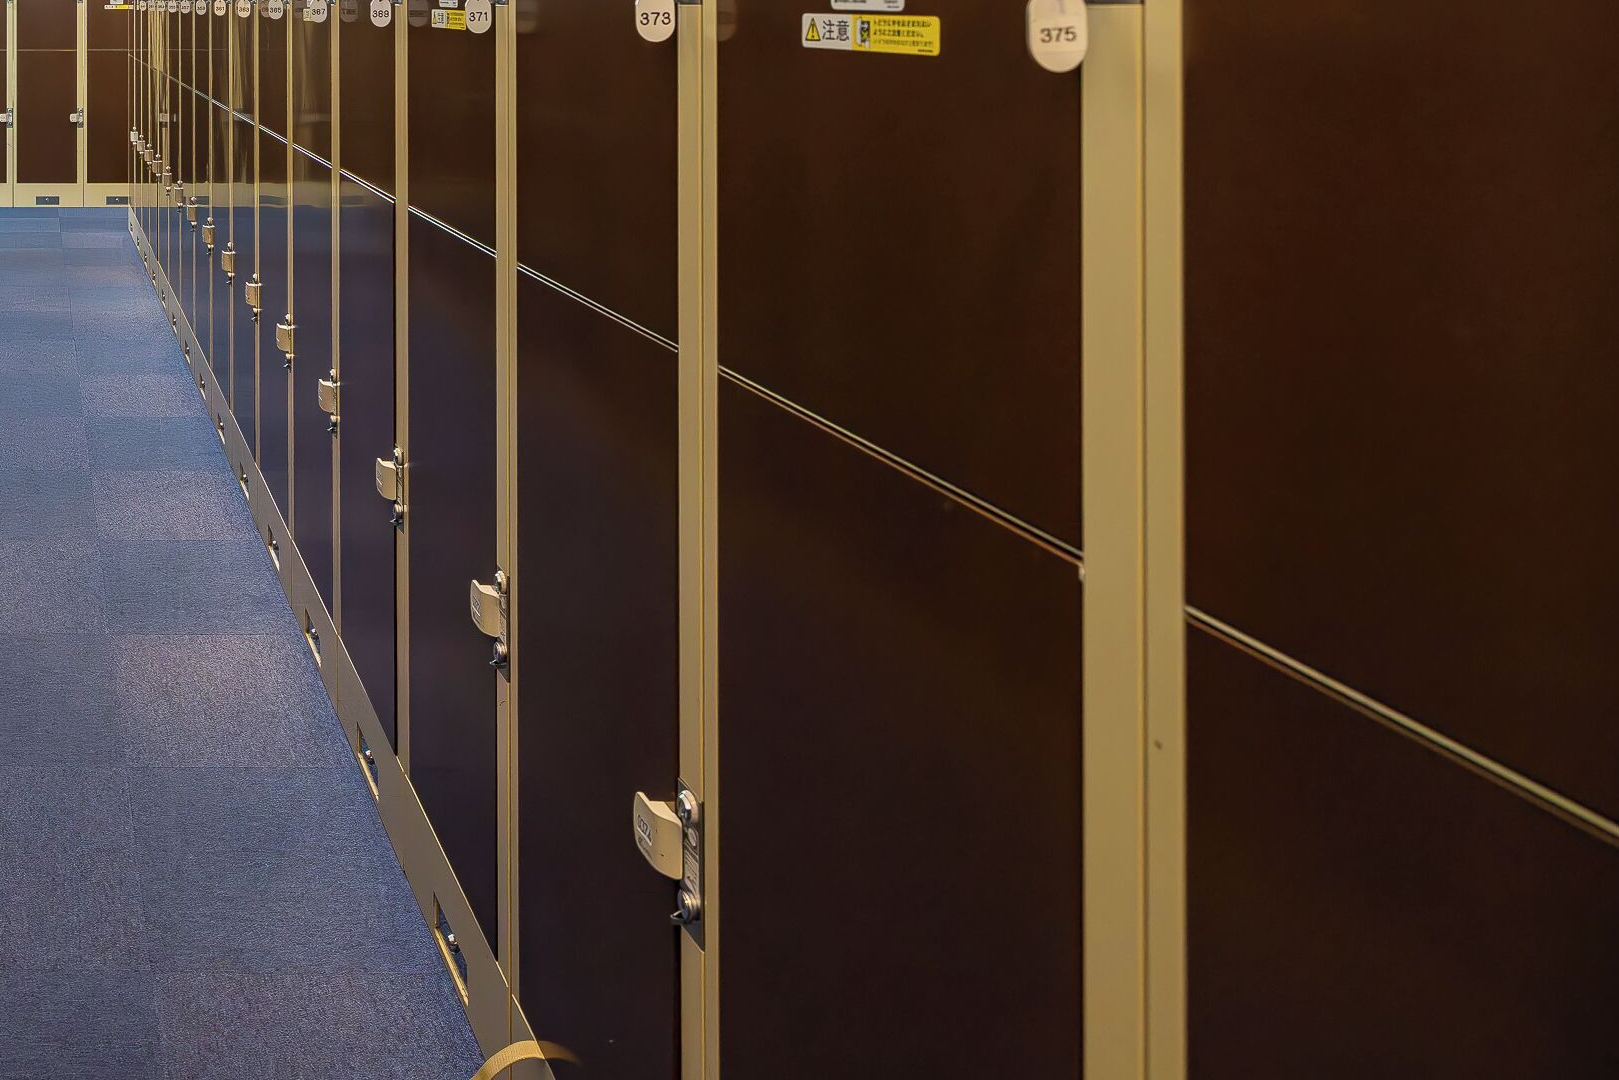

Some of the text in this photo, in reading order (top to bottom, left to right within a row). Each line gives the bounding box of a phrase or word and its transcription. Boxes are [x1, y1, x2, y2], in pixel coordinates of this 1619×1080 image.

[469, 11, 489, 22] 371
[639, 11, 672, 26] 373
[822, 19, 850, 42] 注意
[1040, 25, 1078, 44] 375
